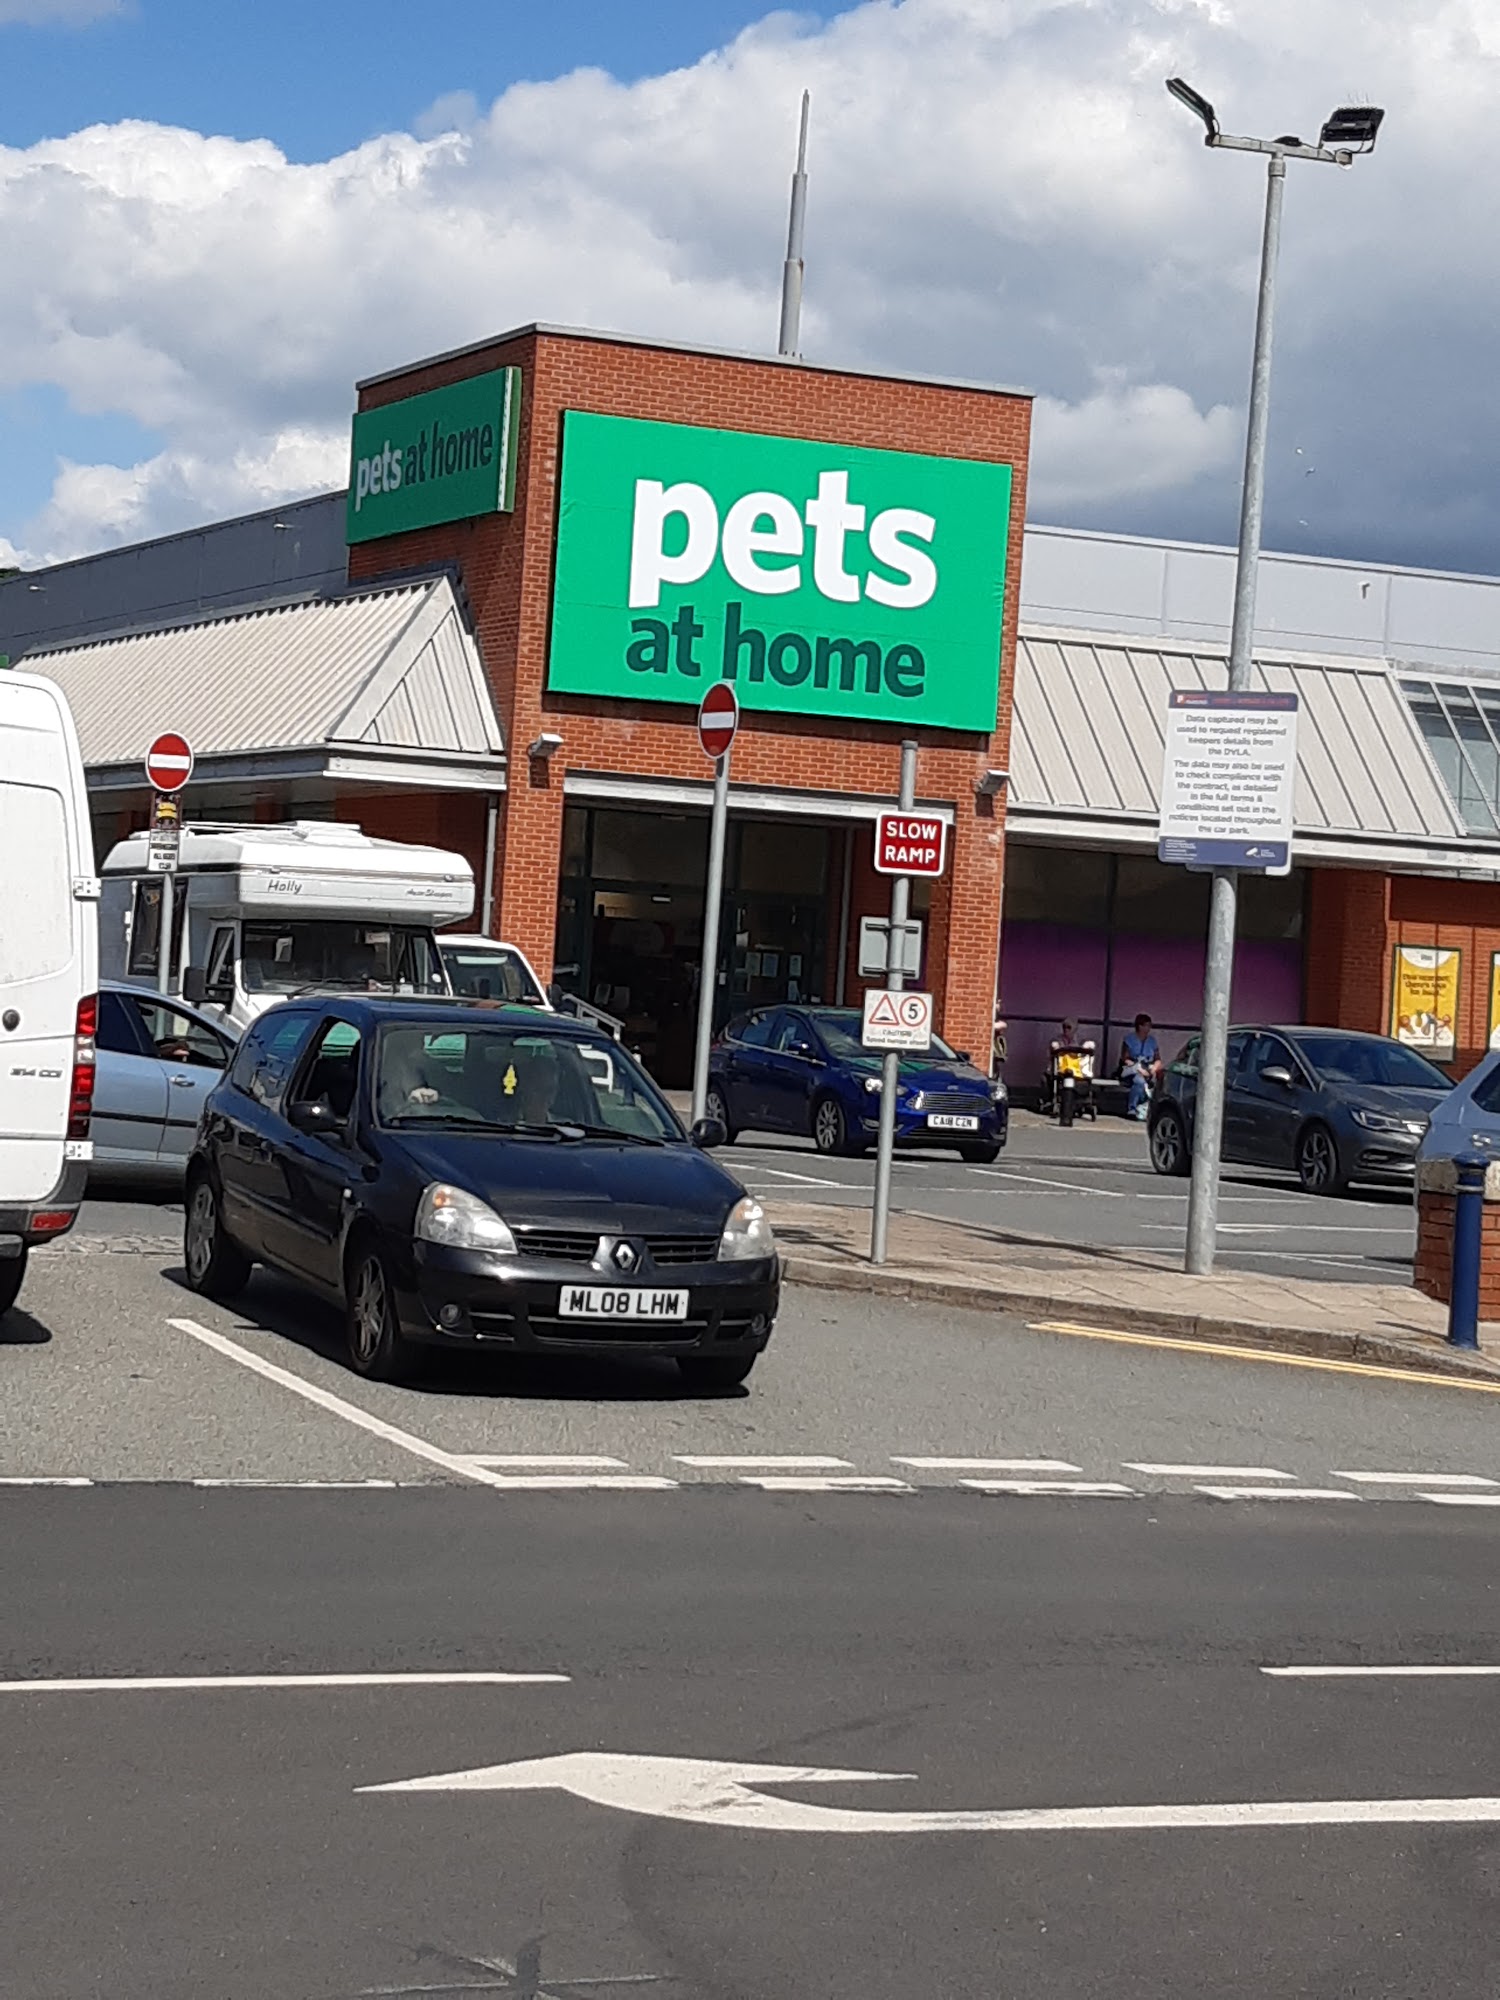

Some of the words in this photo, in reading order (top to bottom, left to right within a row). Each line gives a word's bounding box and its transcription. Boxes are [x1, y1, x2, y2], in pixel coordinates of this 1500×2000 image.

[355, 439, 402, 512] pets
[405, 430, 427, 486] at
[430, 421, 493, 479] home
[628, 470, 937, 609] pets
[625, 605, 704, 677] at
[722, 601, 926, 697] home
[1208, 716, 1245, 724] captured
[1210, 727, 1241, 735] request
[1213, 773, 1260, 781] compliance
[886, 821, 937, 840] SLOW
[885, 845, 936, 864] RAMP
[268, 879, 302, 894] Holly
[908, 1003, 918, 1020] 5
[569, 1290, 630, 1313] ML08
[636, 1292, 680, 1315] LHM
